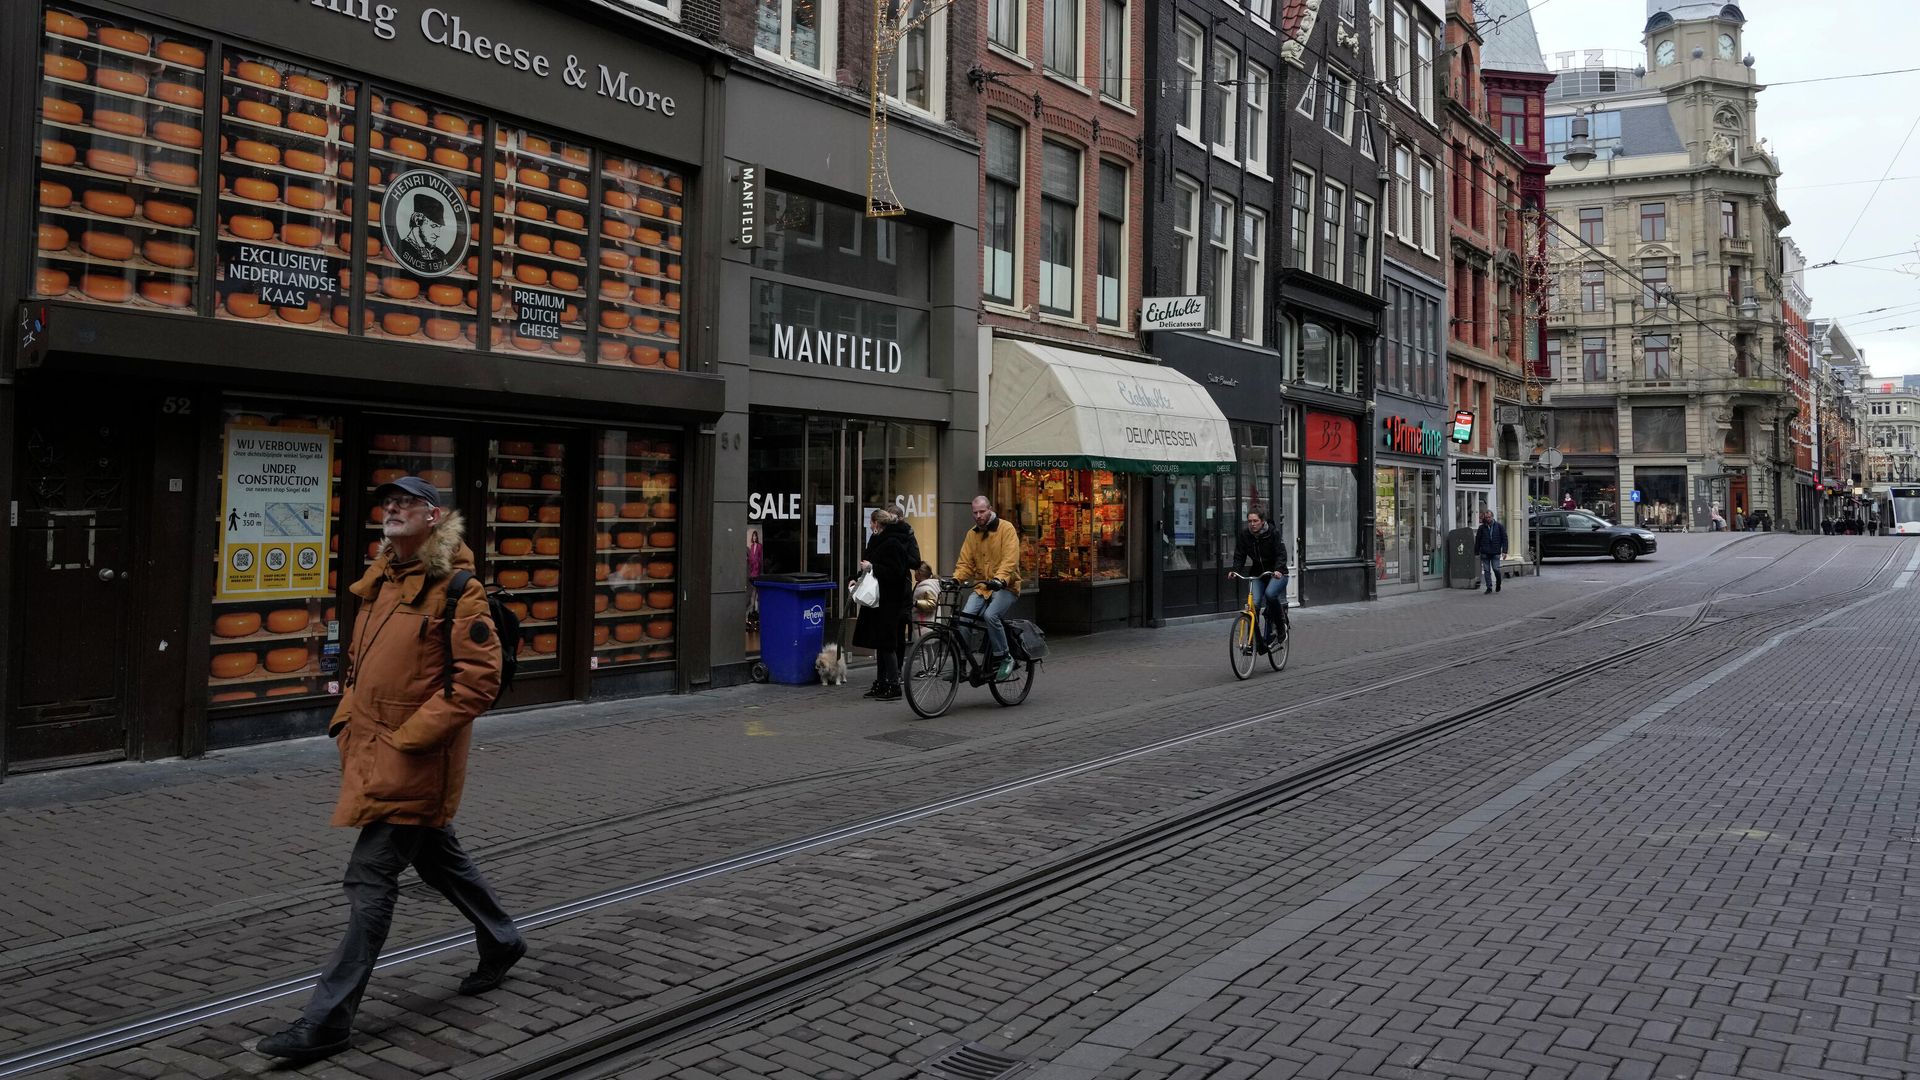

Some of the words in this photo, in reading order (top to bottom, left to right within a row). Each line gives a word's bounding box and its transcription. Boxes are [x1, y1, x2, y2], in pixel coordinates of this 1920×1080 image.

[420, 8, 550, 78] Cheese
[562, 54, 588, 90] &
[598, 64, 676, 117] More
[1541, 49, 1604, 68] TZ
[391, 175, 425, 201] HENRI
[428, 175, 462, 213] WILLIG
[742, 167, 754, 244] MANFIELD
[240, 246, 329, 274] EXCLUSIEVE
[402, 251, 426, 270] SINCE
[428, 259, 449, 271] 1974
[229, 264, 337, 293] NEDERLANDSE
[261, 286, 305, 307] KAAS
[514, 290, 565, 310] PREMIUM
[521, 307, 559, 324] DUTCH
[1146, 298, 1202, 324] Eichholtz
[519, 322, 560, 340] CHEESE
[1159, 320, 1202, 328] Delicatessen
[773, 323, 902, 374] MANFIELD
[162, 395, 191, 416] 52
[237, 439, 255, 450] WIJ
[258, 440, 322, 452] VERBOUWEN
[721, 432, 741, 450] 50
[1125, 426, 1198, 447] DELICATESSEN
[262, 463, 296, 474] UNDER
[986, 460, 999, 468] U.S.
[1001, 460, 1017, 468] AND
[1018, 460, 1046, 468] BRITISH
[1047, 460, 1069, 468] FOOD
[1091, 460, 1107, 469] WINES
[1152, 464, 1179, 473] CHOCOLATES
[237, 474, 319, 486] CONSTRUCTION
[748, 492, 801, 520] SALE
[895, 494, 936, 518] SALE
[242, 519, 254, 527] 350
